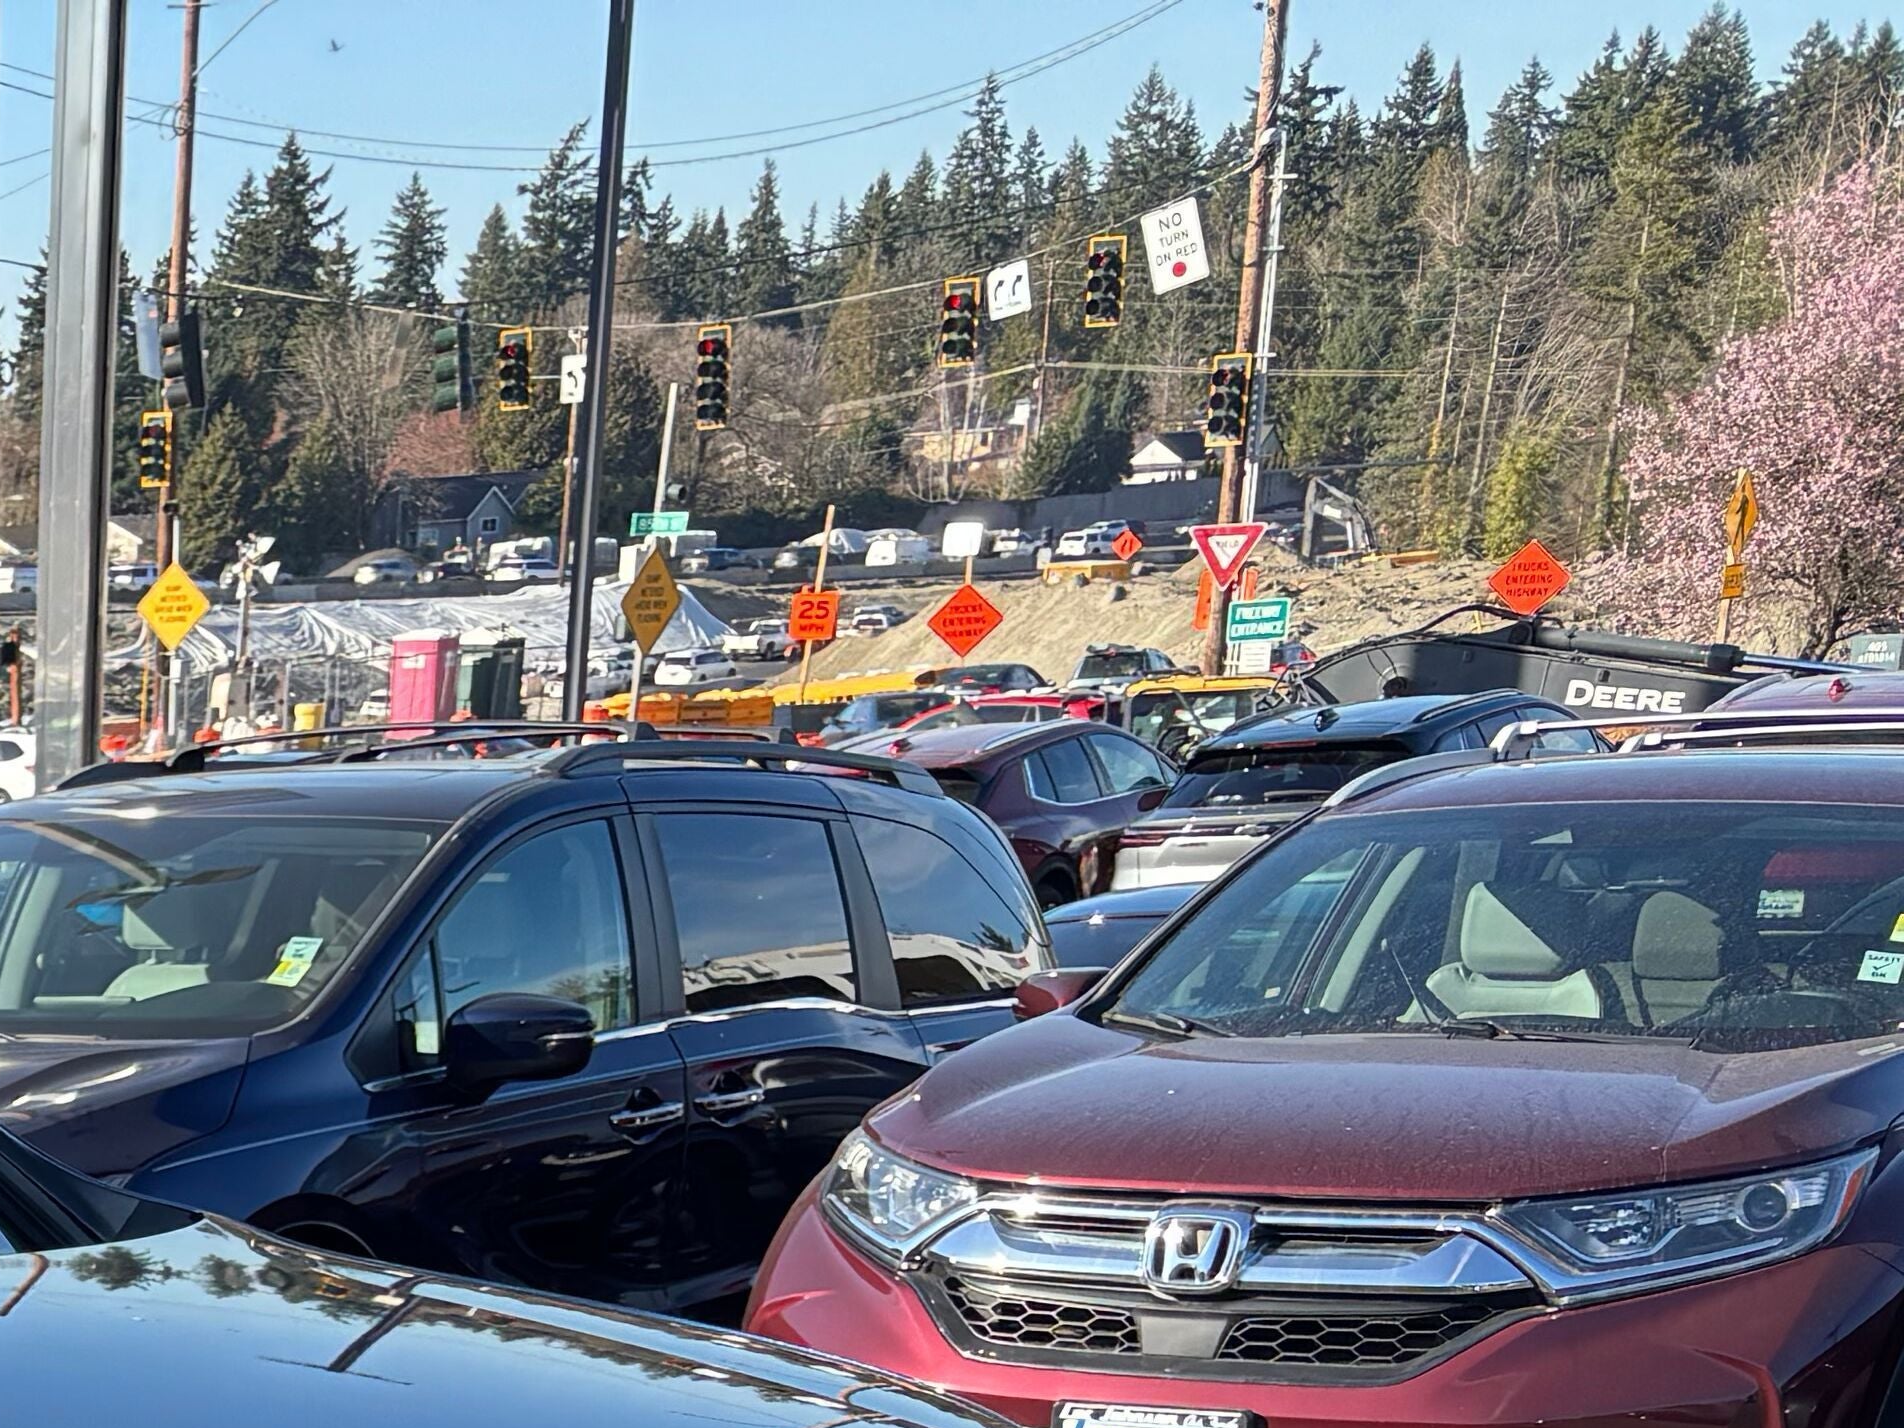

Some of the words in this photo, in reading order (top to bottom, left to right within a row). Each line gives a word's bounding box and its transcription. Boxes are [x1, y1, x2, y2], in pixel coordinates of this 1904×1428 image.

[1158, 212, 1182, 232] NO
[1159, 229, 1189, 248] TURN
[1155, 252, 1171, 266] ON
[1175, 242, 1198, 257] RED
[1512, 561, 1549, 572] TRUCKS
[1505, 574, 1553, 585] ENTERING
[1506, 587, 1549, 597] HIGHWAY
[798, 600, 830, 619] 25
[1563, 679, 1687, 714] DEERE
